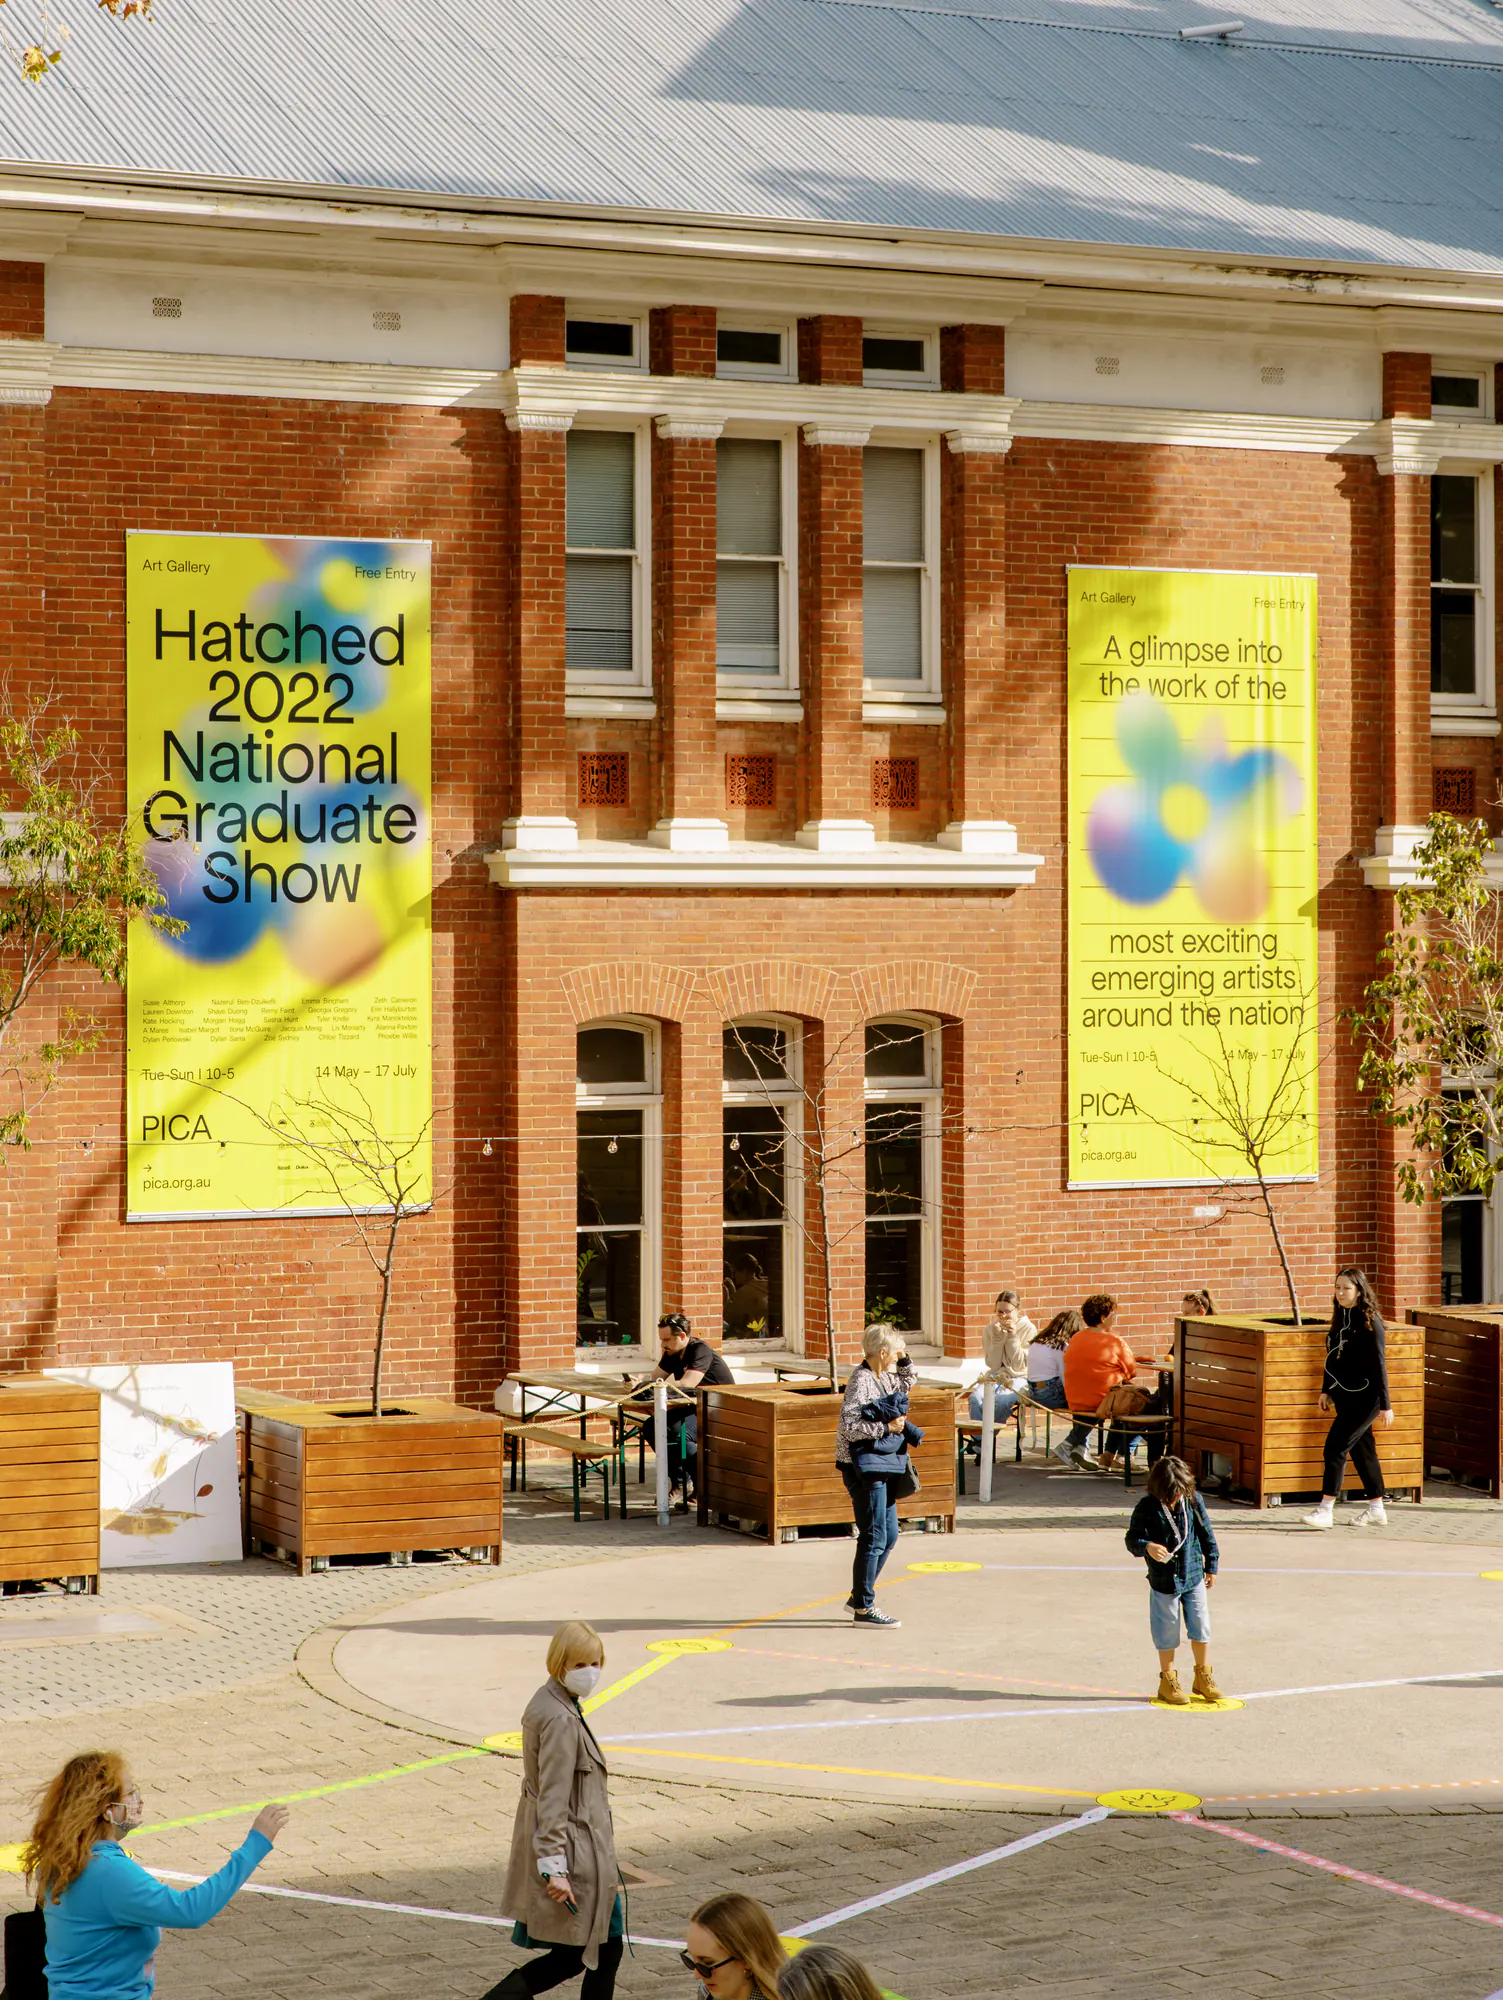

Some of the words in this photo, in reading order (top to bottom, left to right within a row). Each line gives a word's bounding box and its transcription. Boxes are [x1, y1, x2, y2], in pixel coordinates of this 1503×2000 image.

[142, 559, 163, 571] Art
[166, 559, 211, 576] Gallery
[354, 566, 382, 579] Free
[385, 567, 417, 583] Entry
[1080, 591, 1097, 603] Art
[1100, 591, 1137, 606] Gallery
[1254, 597, 1276, 608] Free
[1279, 598, 1306, 612] Entry
[155, 608, 405, 667] Hatched
[1103, 634, 1122, 660] A
[1129, 634, 1230, 668] glimpse
[1237, 637, 1283, 664] into
[1099, 670, 1141, 697] the
[1148, 672, 1208, 699] work
[1215, 673, 1240, 699] of
[1246, 674, 1287, 700] the
[208, 670, 355, 724] 2022
[163, 728, 398, 785] National
[142, 789, 418, 844] Graduate
[201, 849, 362, 904] Show
[1110, 930, 1174, 954] most
[1181, 927, 1278, 960] exciting
[1091, 964, 1215, 997] emerging
[1222, 963, 1296, 989] artists
[301, 997, 320, 1005] Emma
[142, 1008, 164, 1016] Lauren
[1082, 1001, 1173, 1028] around
[1180, 1000, 1221, 1027] the
[1229, 999, 1304, 1026] nation
[1080, 1051, 1123, 1063] Tue-Sun
[1132, 1050, 1156, 1062] 10-5
[1238, 1049, 1259, 1064] May
[1271, 1048, 1284, 1060] 17
[142, 1068, 194, 1081] Tue-Sun
[206, 1067, 235, 1080] 10-5
[316, 1066, 331, 1078] 14
[334, 1065, 360, 1080] May
[375, 1064, 390, 1077] 17
[393, 1064, 417, 1079] July
[1080, 1092, 1138, 1117] PICA
[142, 1114, 213, 1141] PICA
[1081, 1148, 1137, 1163] pica.org.au
[143, 1176, 211, 1192] pica.org.au
